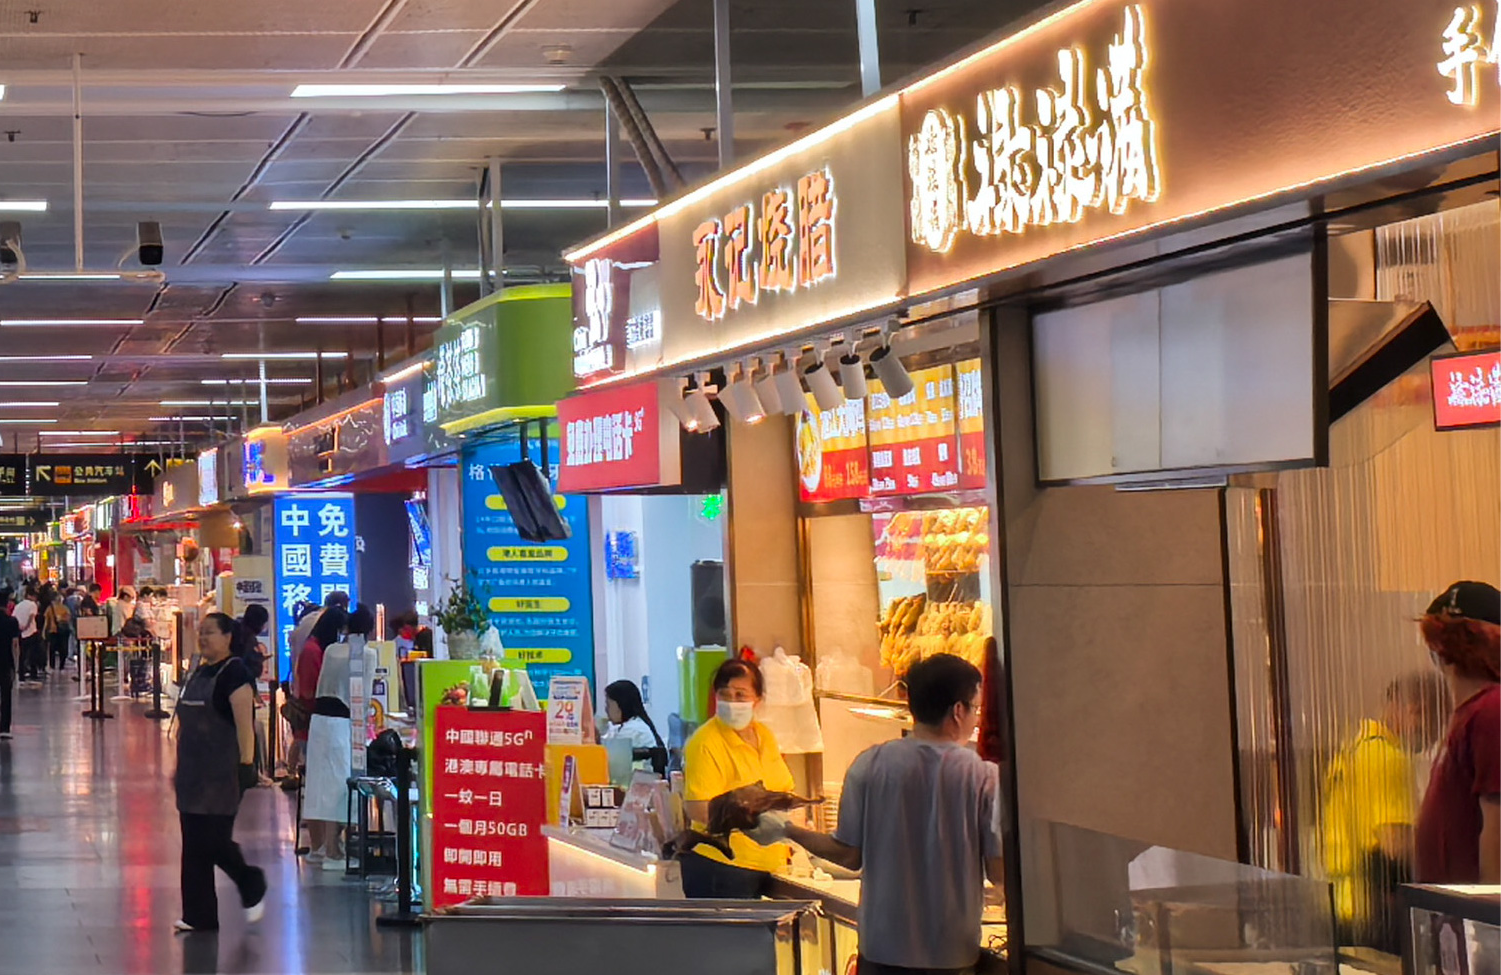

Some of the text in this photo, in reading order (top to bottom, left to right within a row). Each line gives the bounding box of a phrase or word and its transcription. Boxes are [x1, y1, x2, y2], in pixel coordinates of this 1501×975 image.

[74, 465, 125, 477] 公共汽车站
[443, 820, 528, 838] 一個月50GB
